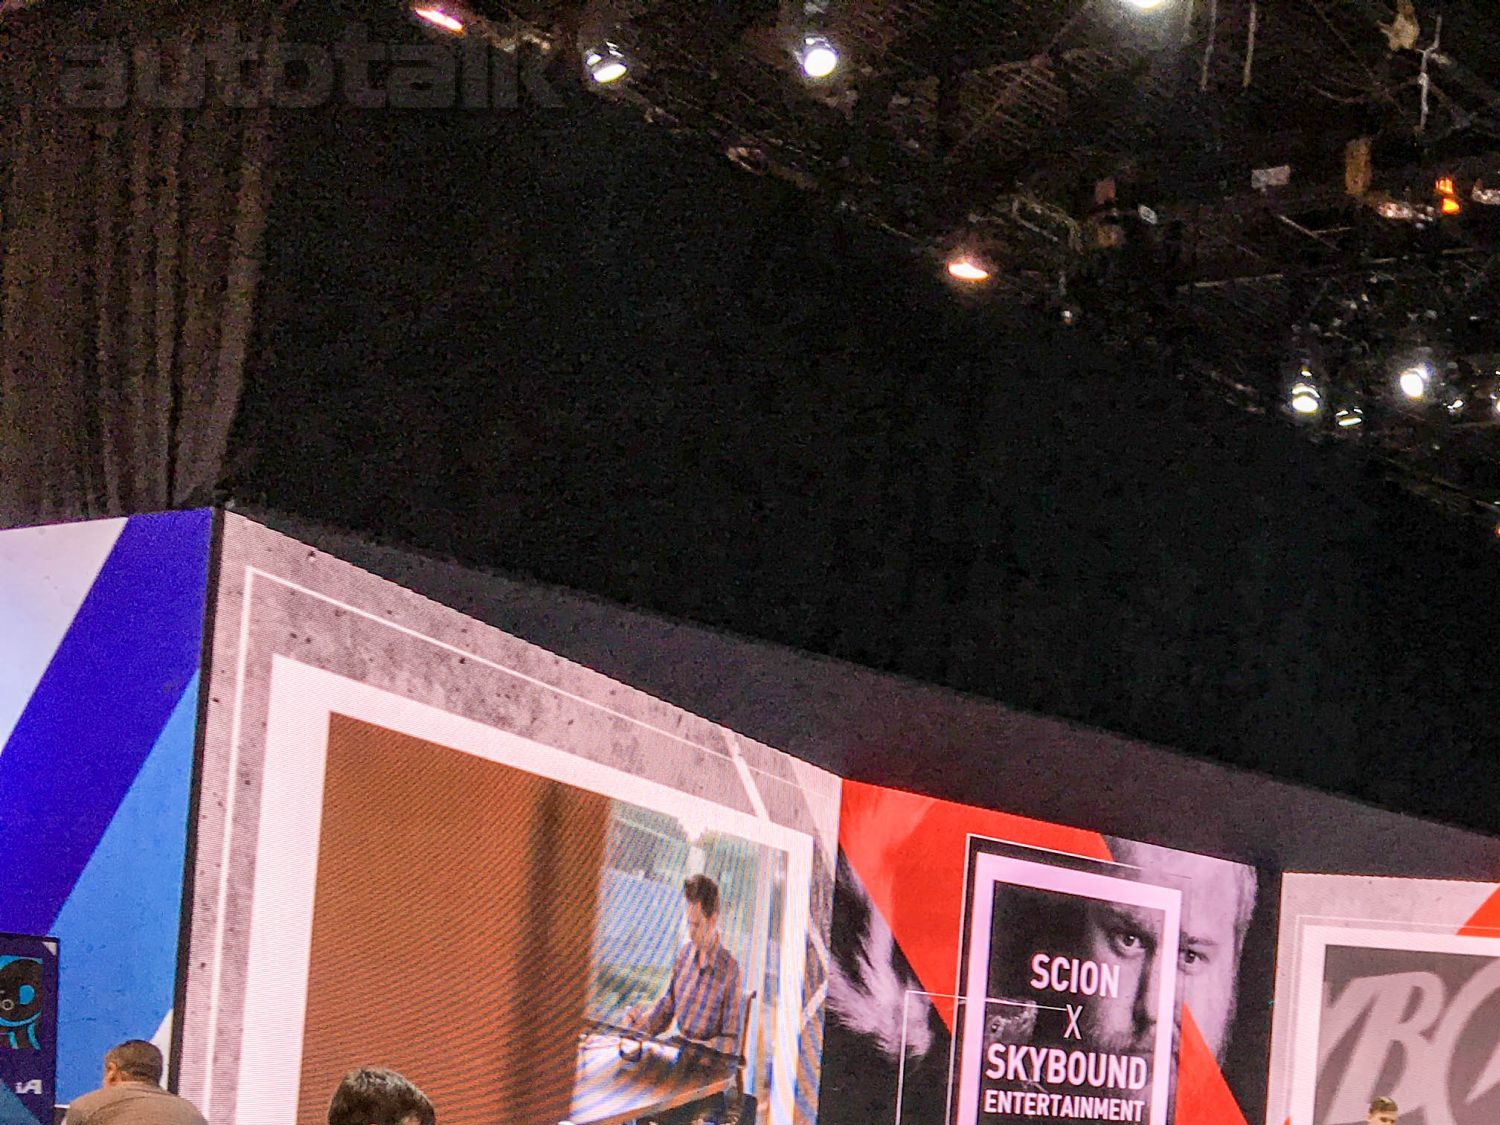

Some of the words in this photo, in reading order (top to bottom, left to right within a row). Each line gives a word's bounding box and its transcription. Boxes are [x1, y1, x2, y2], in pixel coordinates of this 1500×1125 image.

[1030, 953, 1121, 998] SCION
[1063, 1004, 1082, 1039] X
[984, 1043, 1148, 1090] SKYBOUND
[983, 1089, 1146, 1123] ENTERTAINMENT
